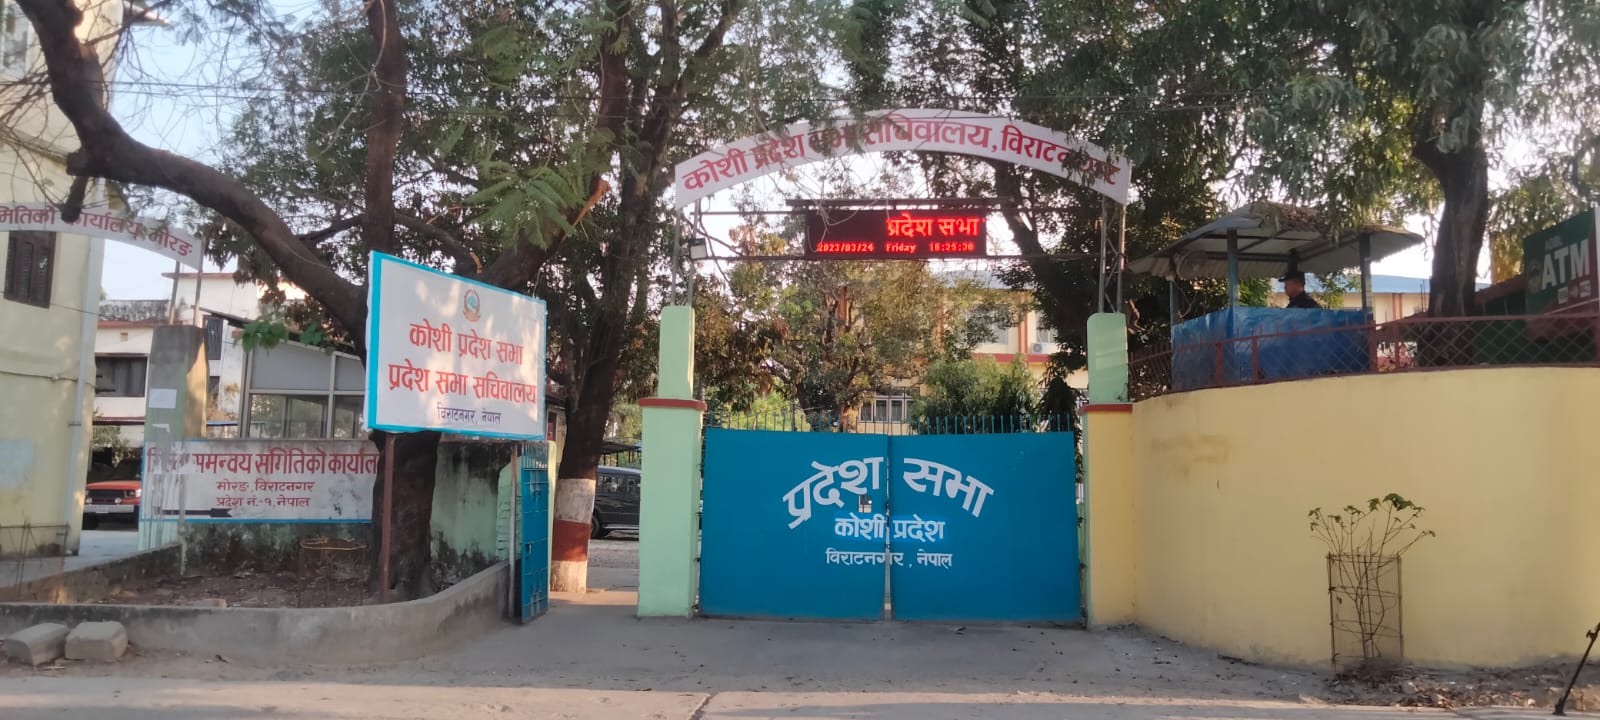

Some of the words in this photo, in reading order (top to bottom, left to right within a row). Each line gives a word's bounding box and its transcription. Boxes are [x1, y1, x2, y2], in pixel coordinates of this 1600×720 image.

[682, 147, 748, 190] कोशी
[751, 133, 806, 170] प्रदेश
[886, 212, 932, 236] प्रदेश
[937, 217, 980, 236] सभा
[816, 242, 874, 252] 2023/03/24
[886, 243, 916, 253] Friday
[1541, 239, 1590, 290] ATM
[409, 318, 452, 353] कोशी
[457, 329, 493, 361] प्रदेश
[496, 341, 524, 366] सभा
[388, 358, 430, 392] प्रदेश
[435, 371, 468, 396] सभा
[473, 371, 538, 404] सचिवालय
[481, 408, 502, 424] नेपाल
[255, 478, 315, 492] विराटनगर
[783, 456, 884, 529] प्रदेश
[903, 457, 994, 518] सभा
[216, 495, 243, 508] प्रदेश
[276, 494, 311, 507] नेपाल
[834, 512, 887, 540] कोशी
[893, 514, 945, 542] प्रदेश
[917, 548, 953, 569] नेपाल
